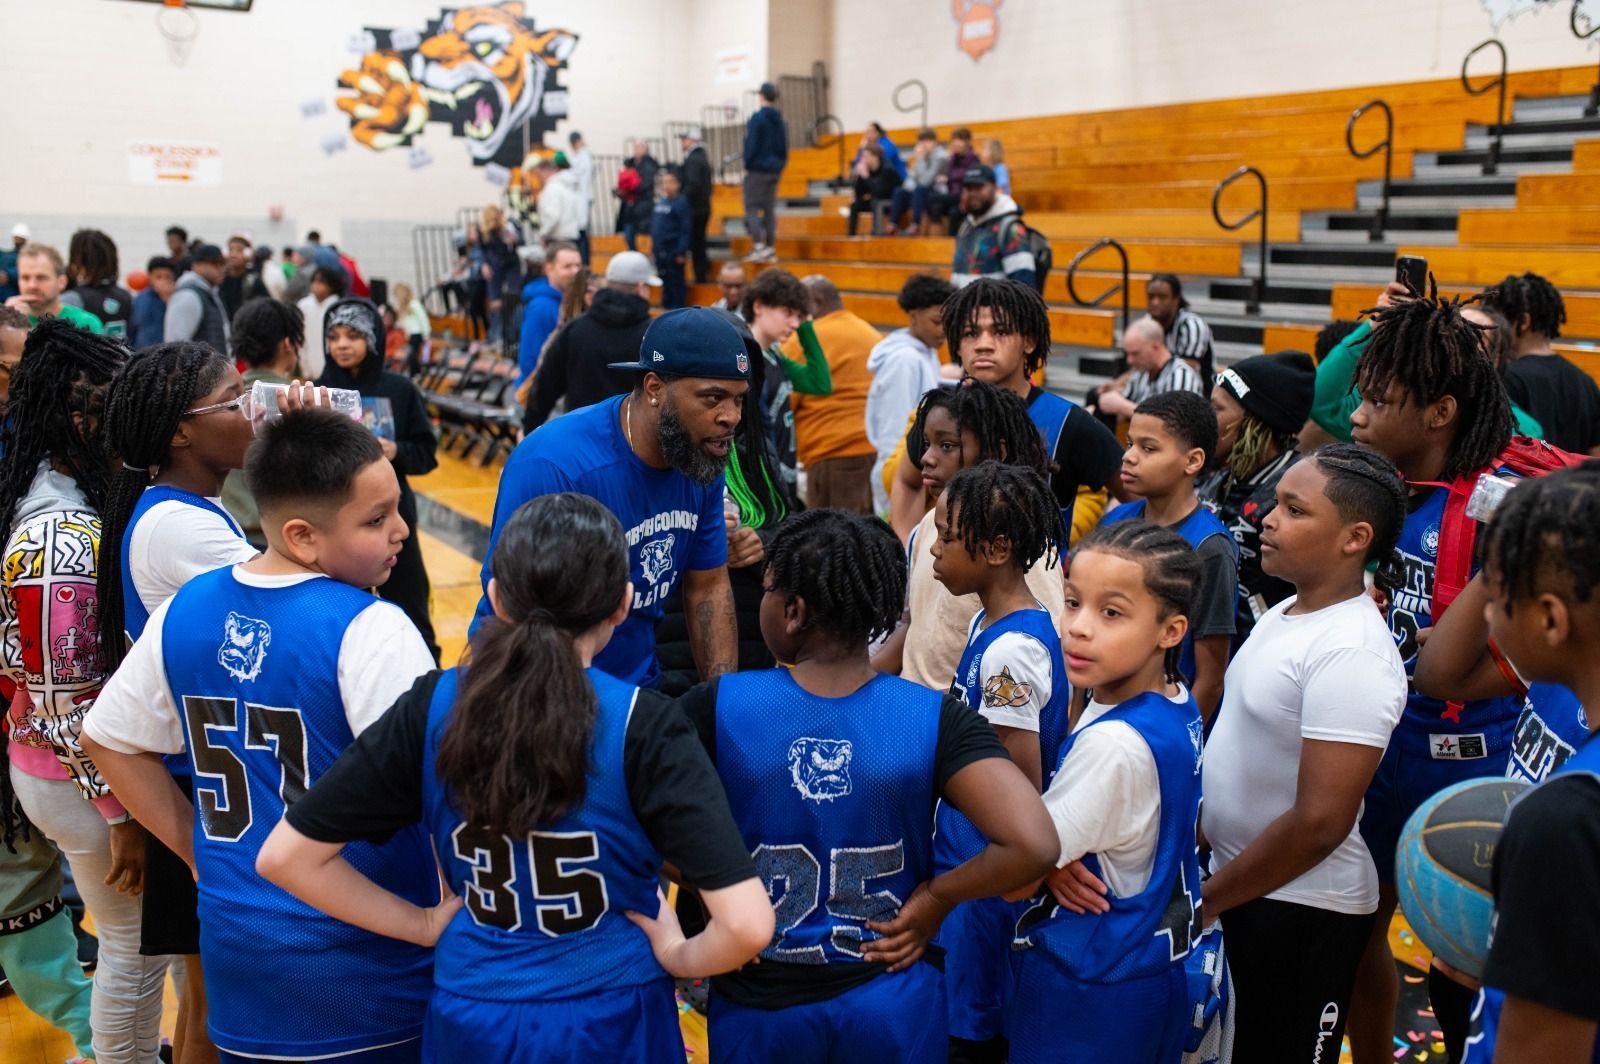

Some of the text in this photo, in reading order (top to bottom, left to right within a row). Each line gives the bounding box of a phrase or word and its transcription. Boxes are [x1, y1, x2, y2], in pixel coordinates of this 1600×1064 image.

[182, 695, 309, 842] 57
[451, 821, 609, 938] 35
[751, 838, 904, 964] 25
